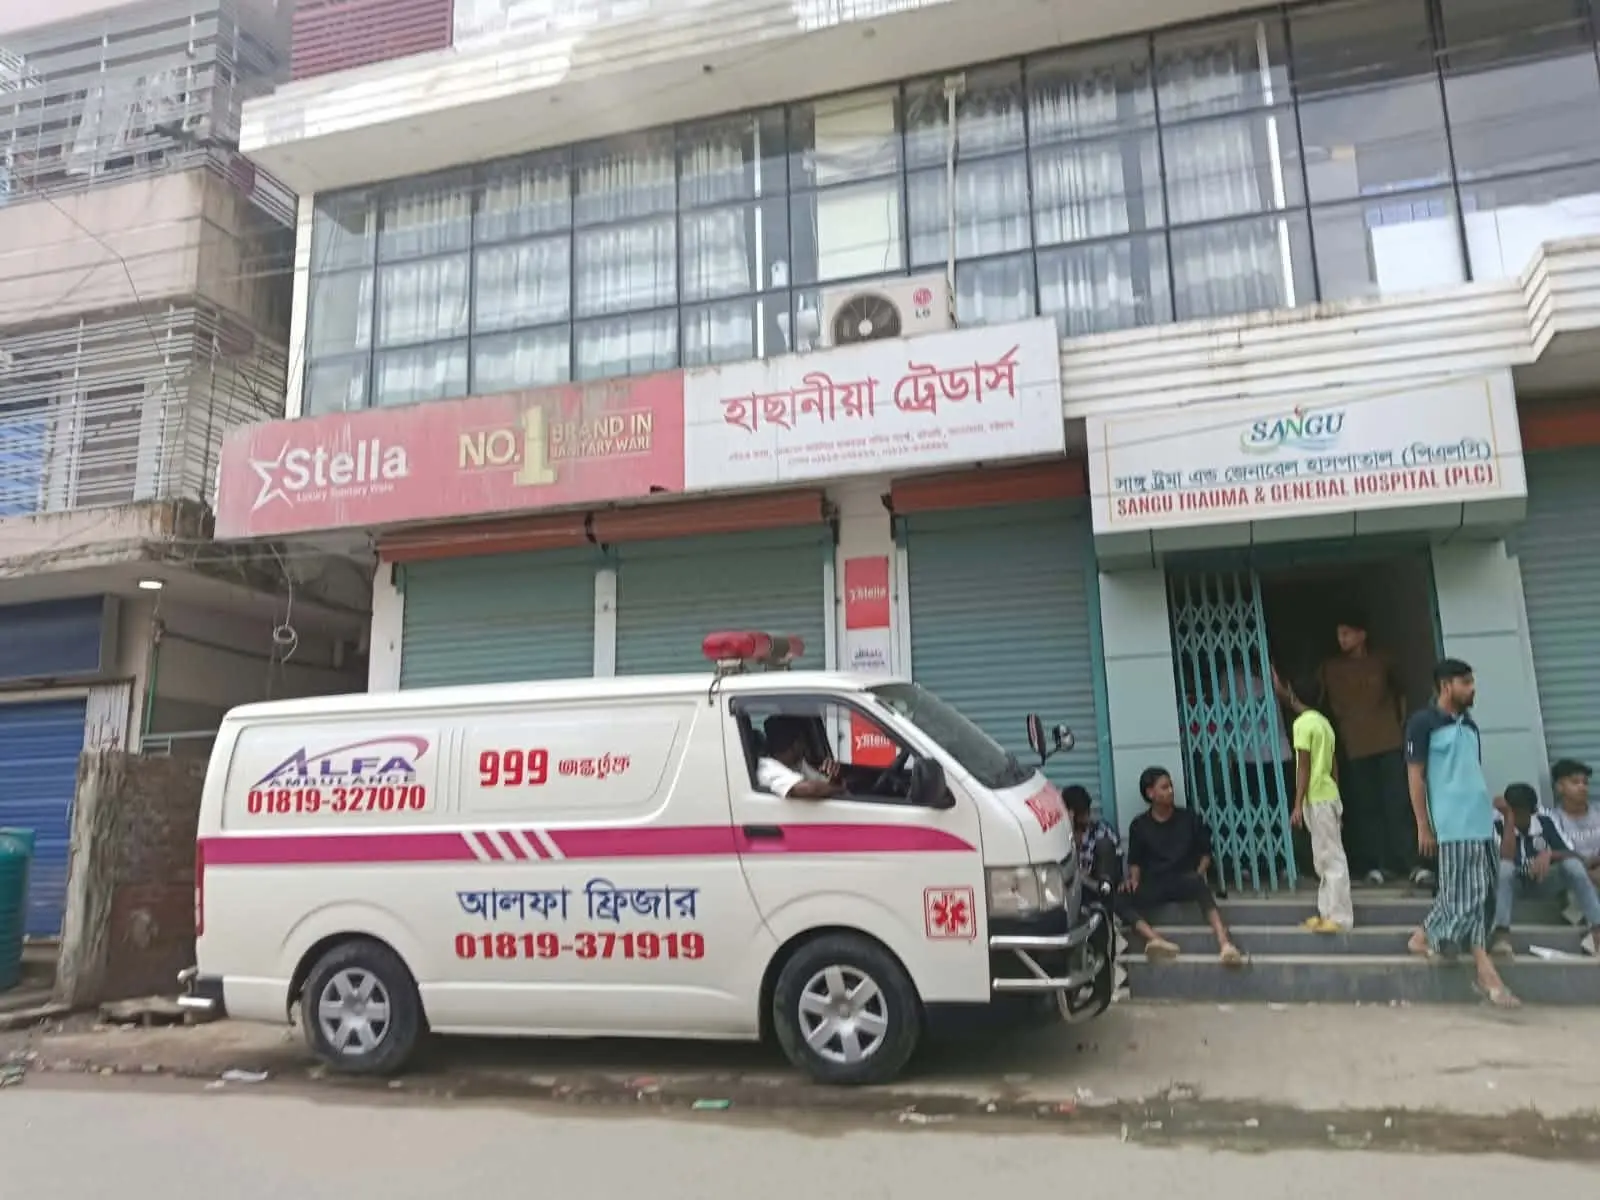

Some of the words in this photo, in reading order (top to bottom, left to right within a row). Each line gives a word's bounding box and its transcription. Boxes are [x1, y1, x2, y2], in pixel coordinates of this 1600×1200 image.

[894, 344, 1020, 415] ট্রেডার্স
[551, 415, 625, 444] BRAND
[631, 411, 652, 435] IN
[1250, 410, 1346, 441] SANGU
[283, 438, 408, 492] Stella
[1117, 493, 1174, 517] SANGU
[1179, 486, 1249, 512] TRAUMA
[1254, 485, 1266, 505] &
[1270, 476, 1348, 504] GENERAL
[1353, 468, 1439, 496] HOSPITAL
[1445, 463, 1493, 489] (PLC)
[251, 745, 417, 789] ALFA
[269, 775, 416, 787] AMBULANCE
[479, 748, 549, 788] 999
[247, 784, 426, 815] 01819-327070
[456, 885, 573, 921] আলফা
[584, 877, 700, 924] ফ্রিজার
[455, 931, 705, 960] 01819-371919
